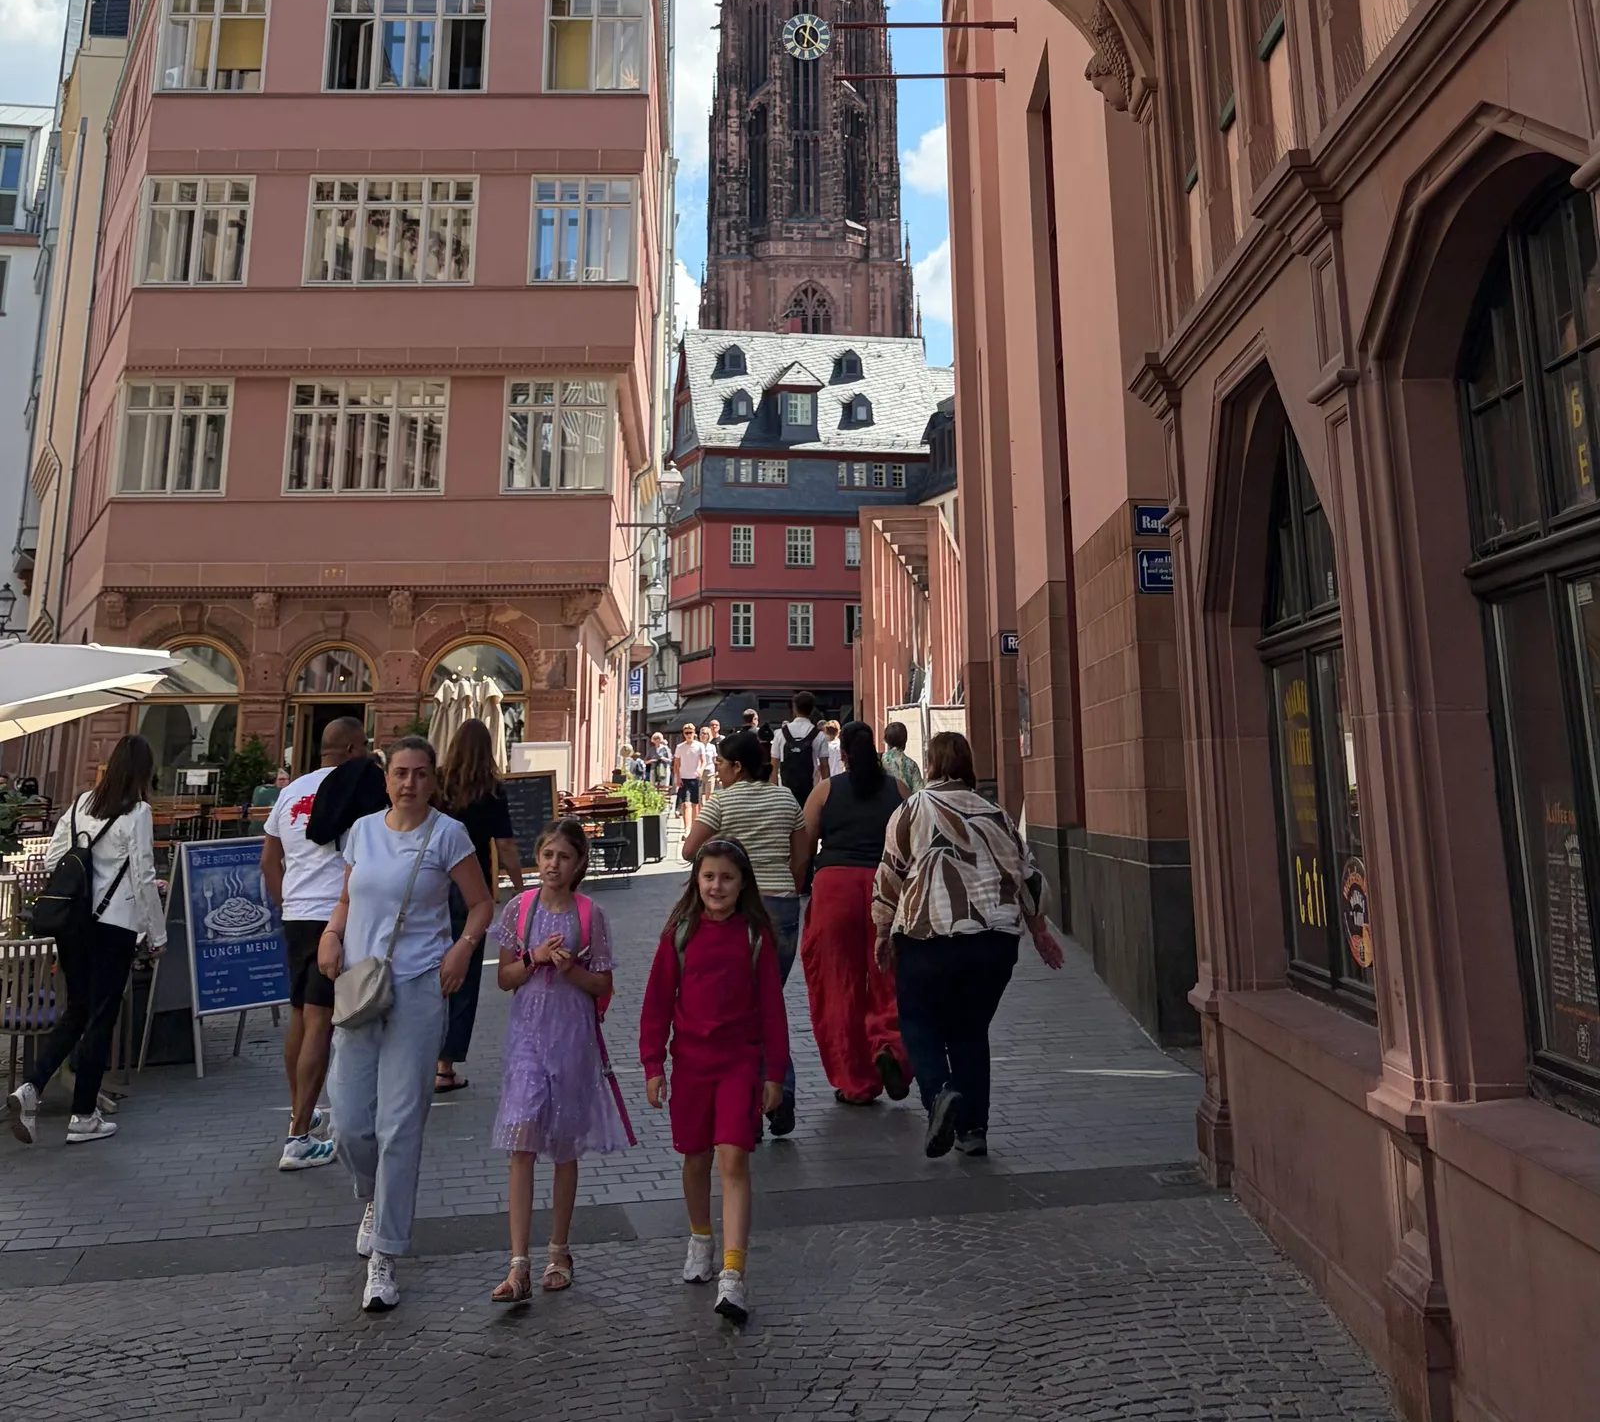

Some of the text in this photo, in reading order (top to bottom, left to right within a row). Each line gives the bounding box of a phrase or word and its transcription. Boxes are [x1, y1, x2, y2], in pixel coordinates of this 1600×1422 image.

[1141, 515, 1169, 533] Rap
[631, 686, 640, 694] P
[1296, 856, 1327, 927] Caf
[202, 941, 278, 959] LUNCH MENU
